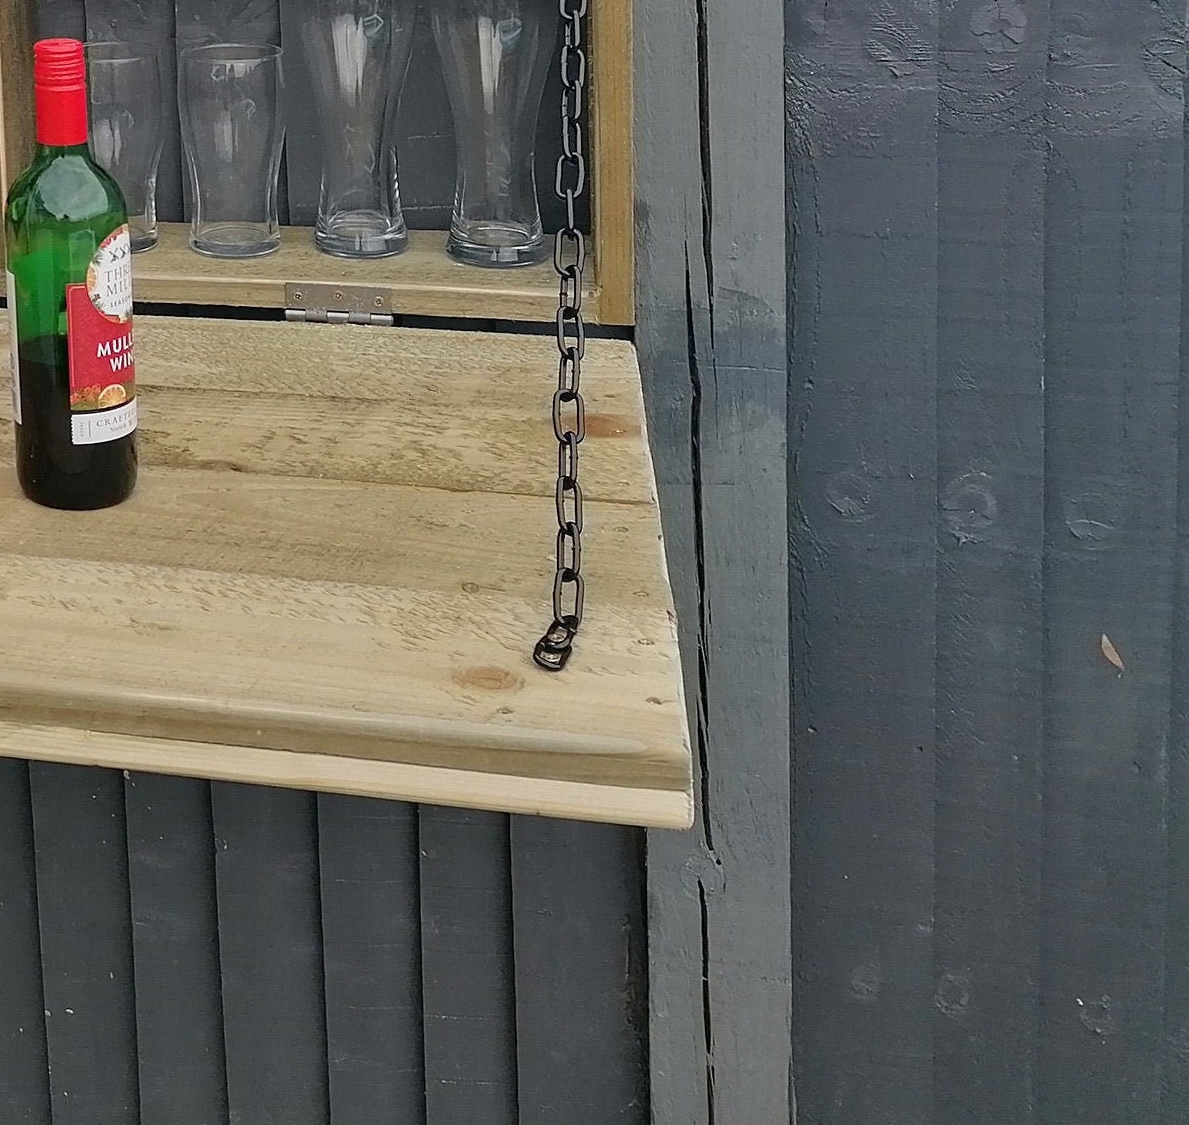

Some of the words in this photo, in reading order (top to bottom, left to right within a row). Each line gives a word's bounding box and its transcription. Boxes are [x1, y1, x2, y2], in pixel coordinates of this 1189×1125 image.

[104, 263, 129, 283] THR
[106, 278, 128, 297] MIL
[97, 332, 134, 358] MULL
[110, 351, 134, 373] WIN
